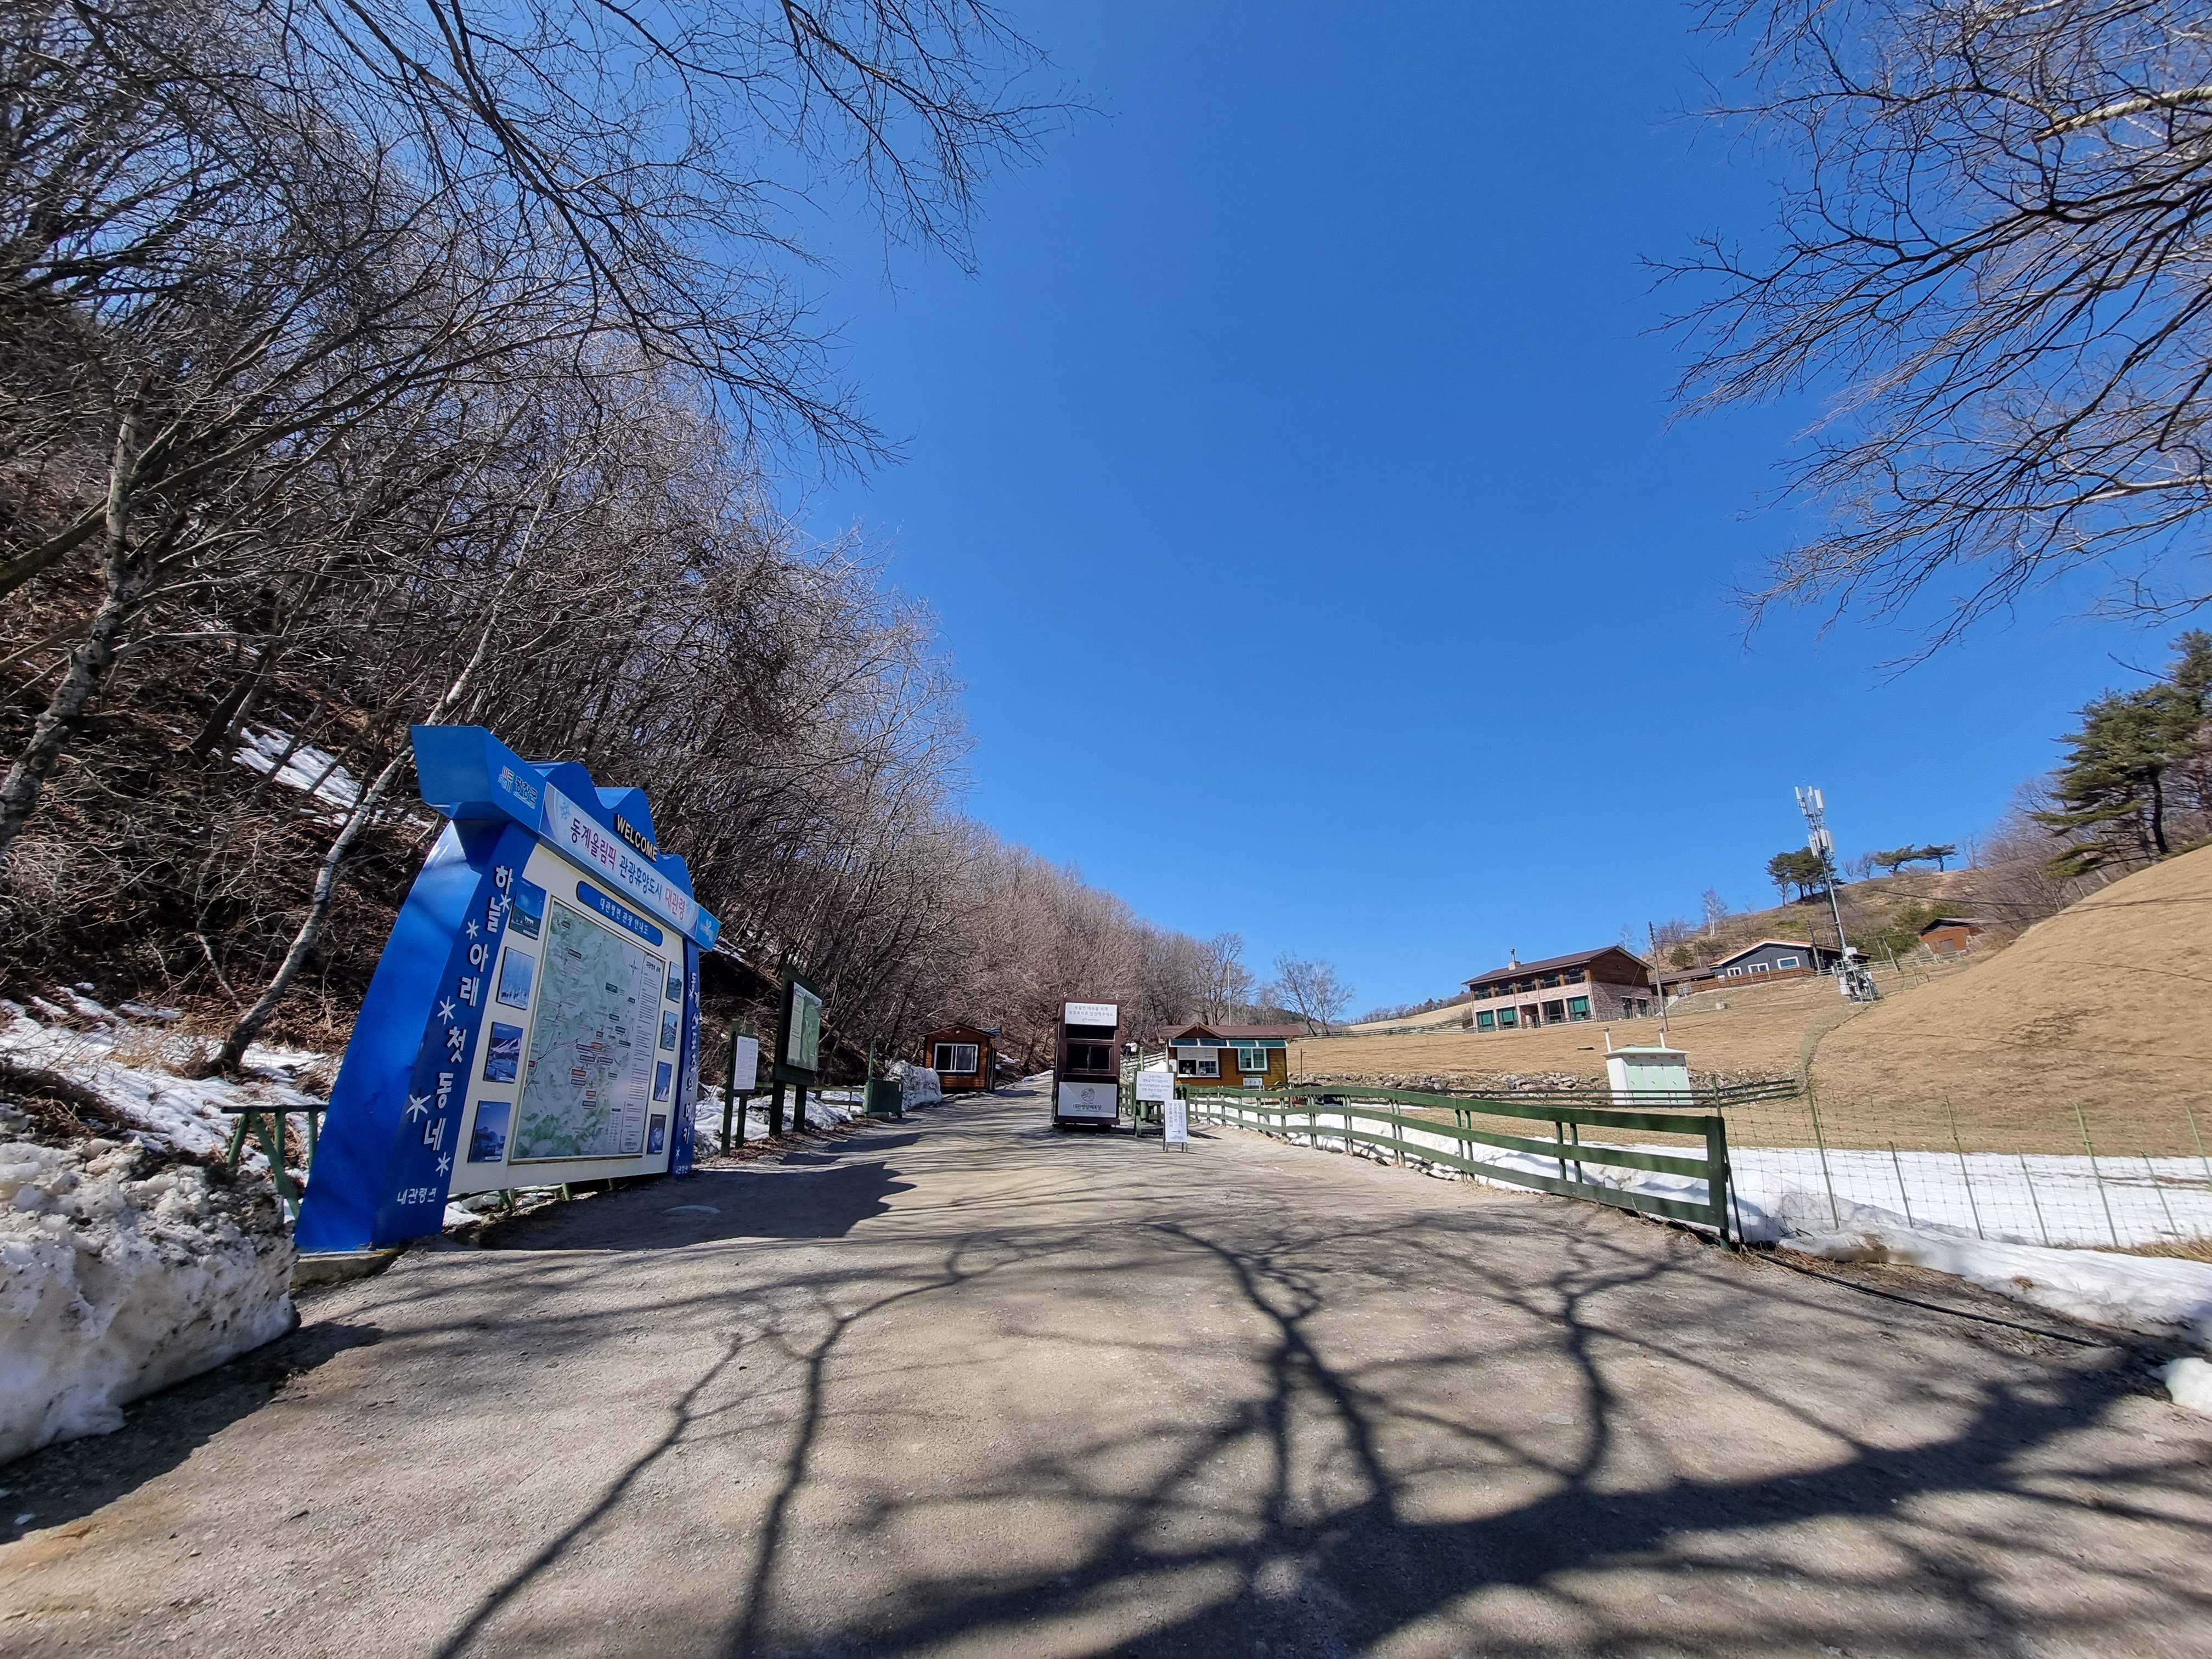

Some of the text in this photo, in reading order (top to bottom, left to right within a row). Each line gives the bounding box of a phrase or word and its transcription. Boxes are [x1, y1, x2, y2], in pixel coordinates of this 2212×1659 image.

[515, 776, 537, 804] 평창군
[617, 814, 658, 862] WELCOME
[570, 817, 686, 921] 동계올림픽 관광휴양도시 대관령
[600, 898, 648, 935] 대관령면 관광 안내도
[423, 865, 514, 1151] 하늘 아래 첫 동네
